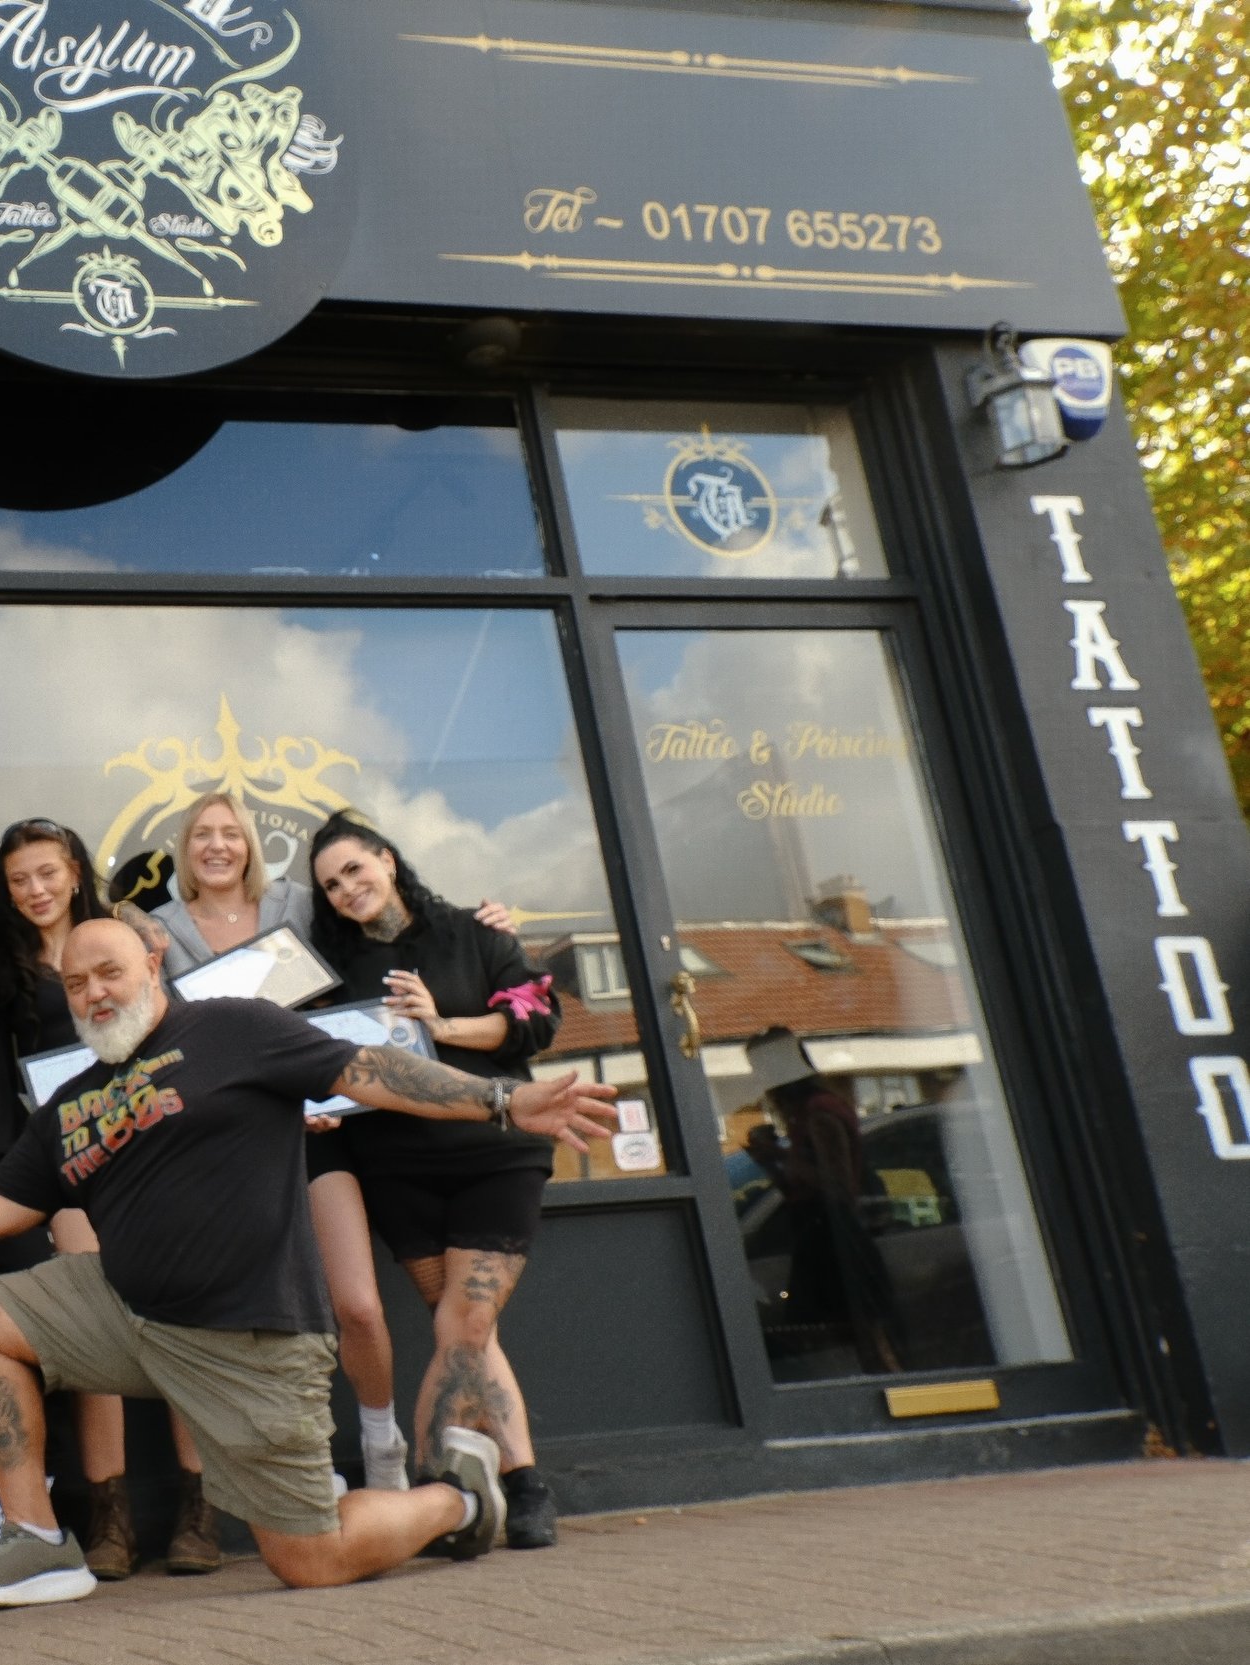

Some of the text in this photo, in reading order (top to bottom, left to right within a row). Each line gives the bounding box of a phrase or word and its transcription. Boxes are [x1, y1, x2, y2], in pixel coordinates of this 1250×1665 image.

[523, 186, 598, 234] Tel
[642, 200, 772, 244] 01707
[786, 208, 943, 255] 655273
[750, 730, 774, 765] &
[1030, 494, 1250, 1160] TATTOO
[61, 1143, 109, 1185] THE
